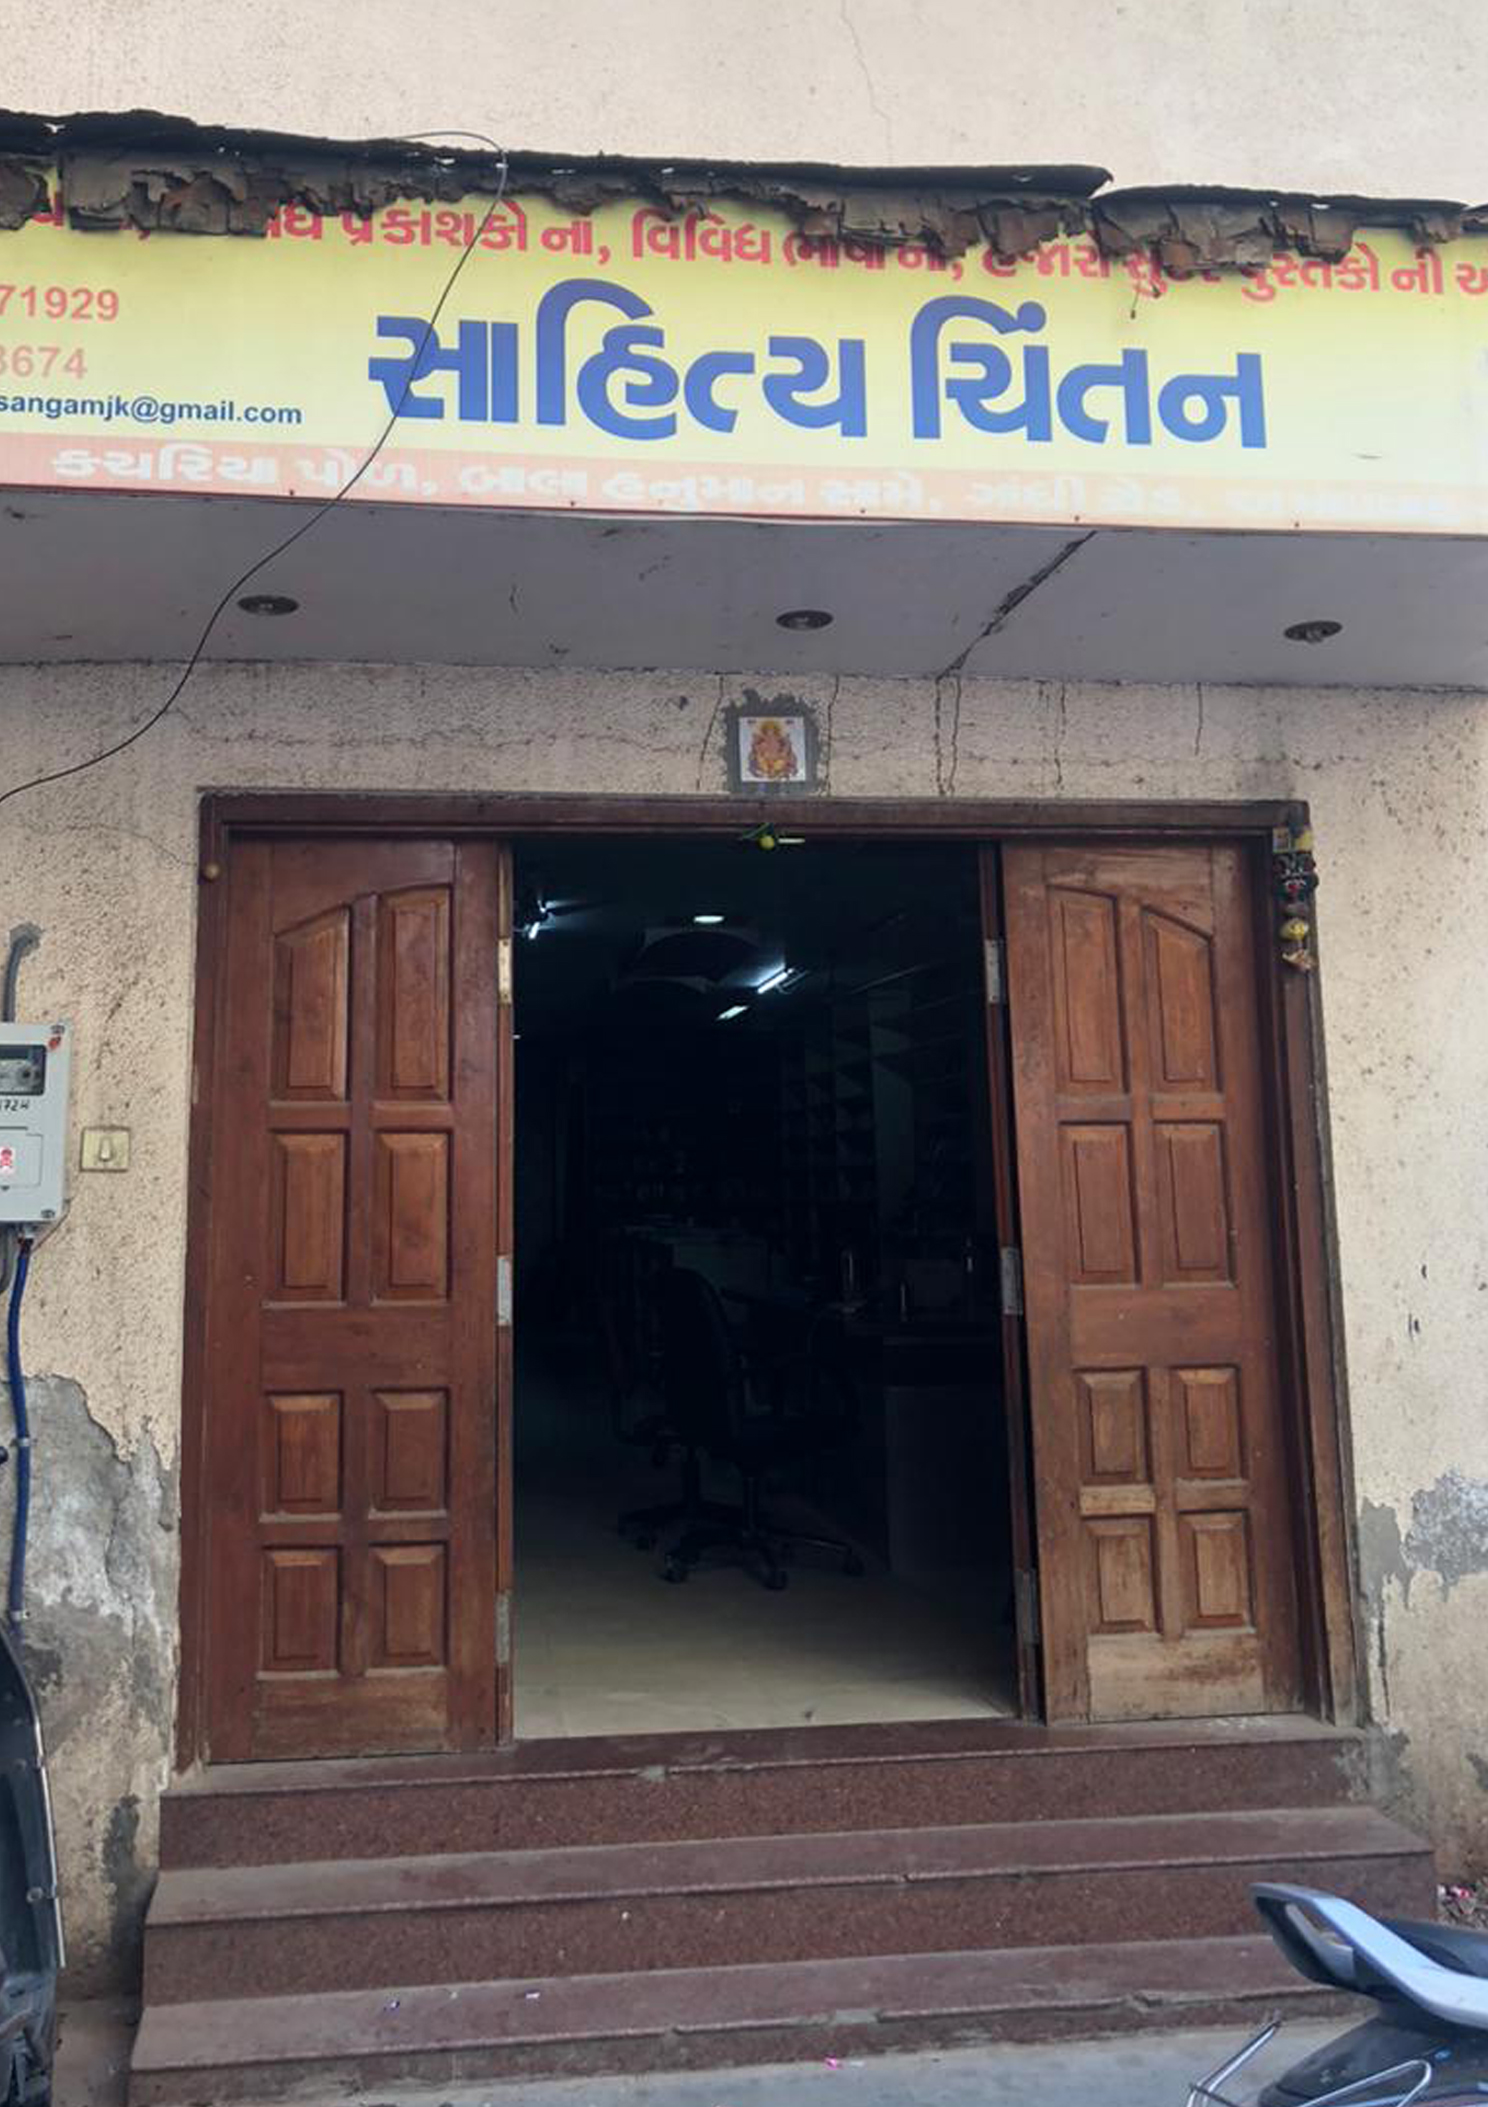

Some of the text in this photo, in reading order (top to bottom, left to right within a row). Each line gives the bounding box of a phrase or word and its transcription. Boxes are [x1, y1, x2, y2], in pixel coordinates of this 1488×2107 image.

[541, 218, 610, 264] ના,
[631, 207, 771, 264] વિવિધ
[0, 285, 119, 320] 71929
[368, 277, 1267, 449] સાહિત્ય ચિંતન
